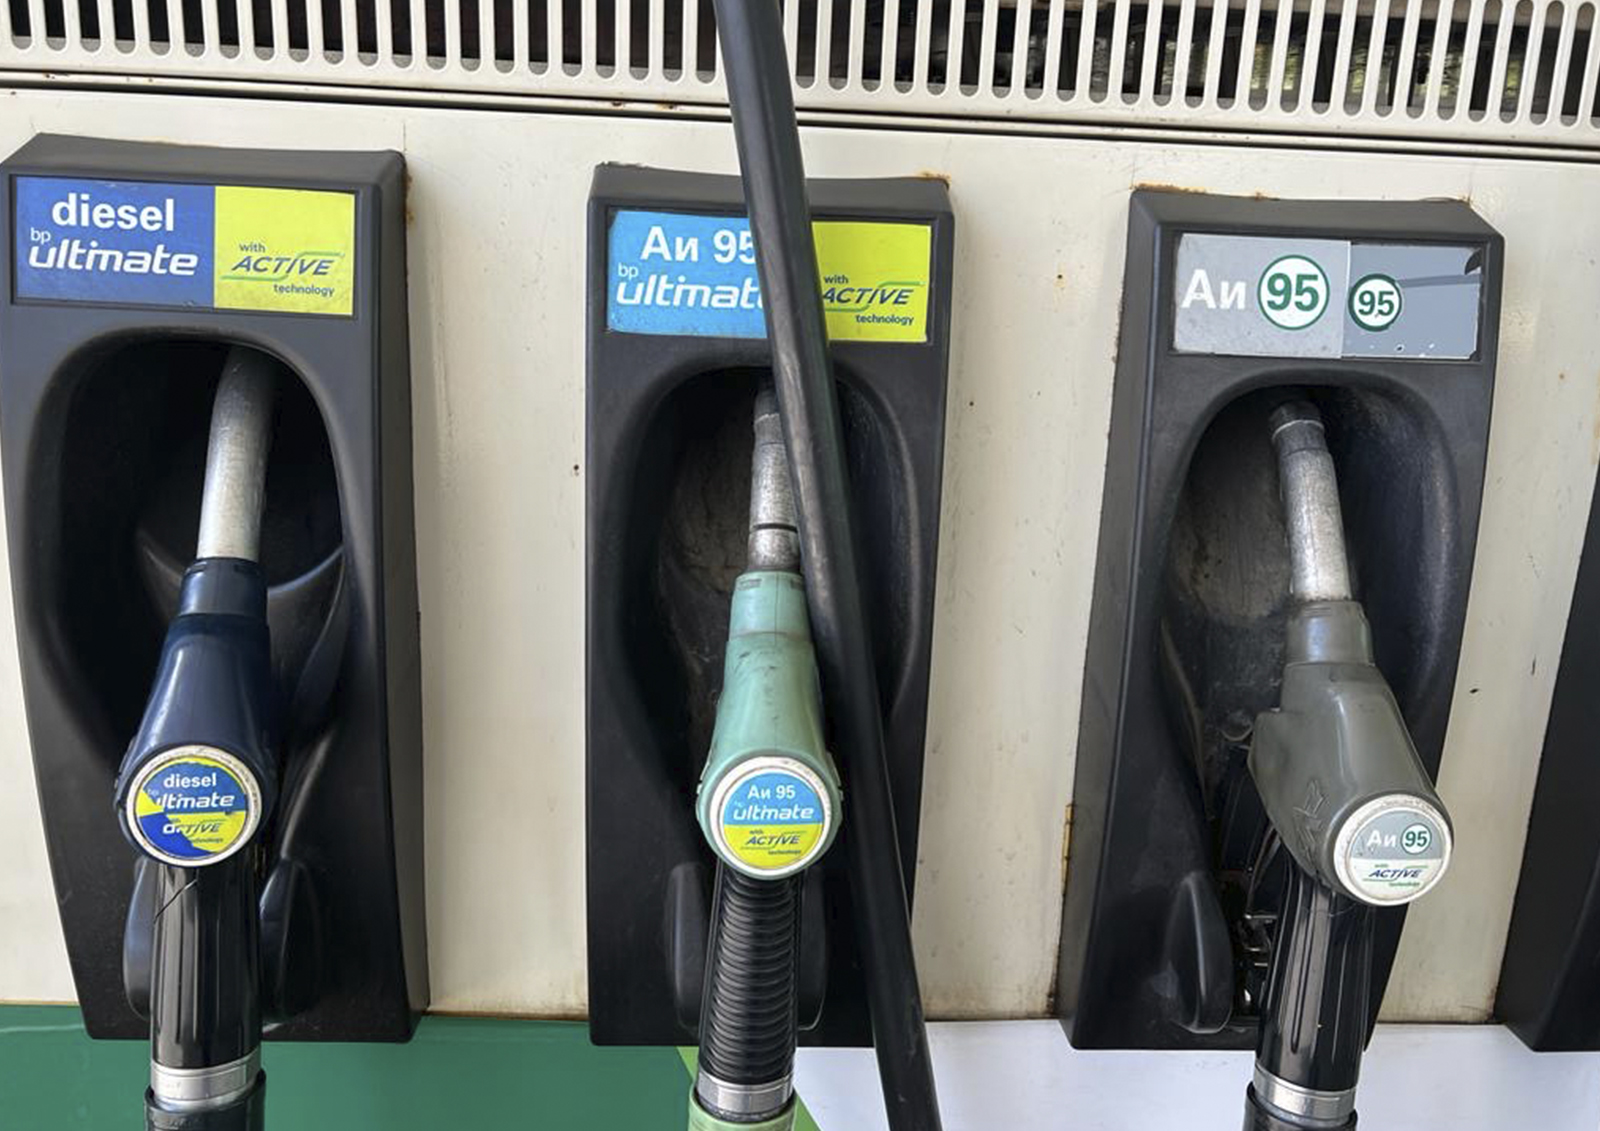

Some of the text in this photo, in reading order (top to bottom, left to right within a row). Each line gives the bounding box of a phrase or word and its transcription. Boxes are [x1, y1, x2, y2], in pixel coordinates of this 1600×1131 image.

[52, 193, 174, 231] diesel
[30, 227, 50, 244] bp
[239, 242, 266, 253] with
[640, 226, 756, 264] Аи 95
[29, 239, 198, 276] ultimate
[231, 256, 334, 276] ACTIVE
[618, 263, 638, 279] bp
[823, 274, 849, 284] with
[273, 283, 335, 297] technology
[616, 274, 763, 309] ultimat
[822, 287, 914, 305] ACTIVE
[1181, 269, 1319, 312] Аи 95
[1357, 290, 1395, 316] 95
[855, 314, 914, 326] technology
[163, 772, 216, 788] diesel
[776, 785, 796, 799] 95
[733, 804, 814, 820] ultimate
[745, 835, 801, 845] ACTIVE
[1404, 831, 1428, 848] 95
[1368, 869, 1422, 878] ACTIVE
